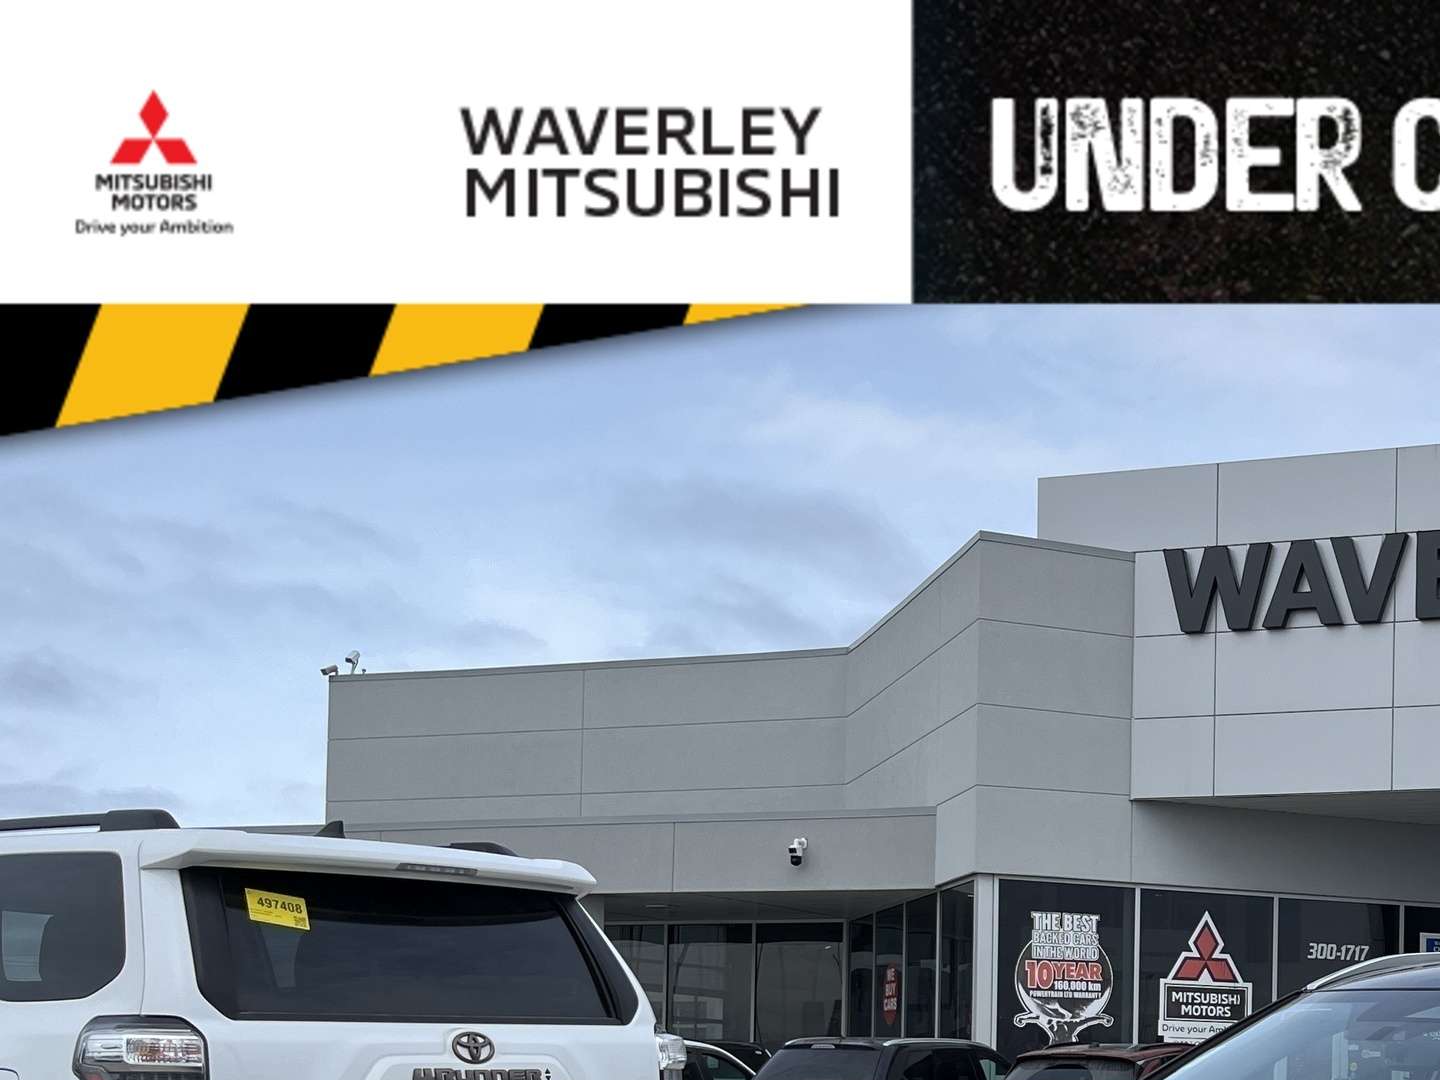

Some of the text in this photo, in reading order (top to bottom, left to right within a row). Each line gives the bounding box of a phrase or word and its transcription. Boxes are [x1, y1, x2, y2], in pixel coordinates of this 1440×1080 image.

[257, 897, 302, 914] 497408
[1032, 911, 1099, 932] THE BEST
[1033, 931, 1099, 946] BACKED CARS
[1064, 947, 1099, 959] WORLD
[1307, 943, 1369, 961] 300-1717
[1025, 960, 1102, 989] 10 YEAR
[1088, 981, 1101, 991] km
[1171, 991, 1240, 1005] MITSUBISHI
[1181, 1004, 1231, 1017] MOTORS
[1162, 1023, 1185, 1033] Drive
[1187, 1025, 1207, 1034] your
